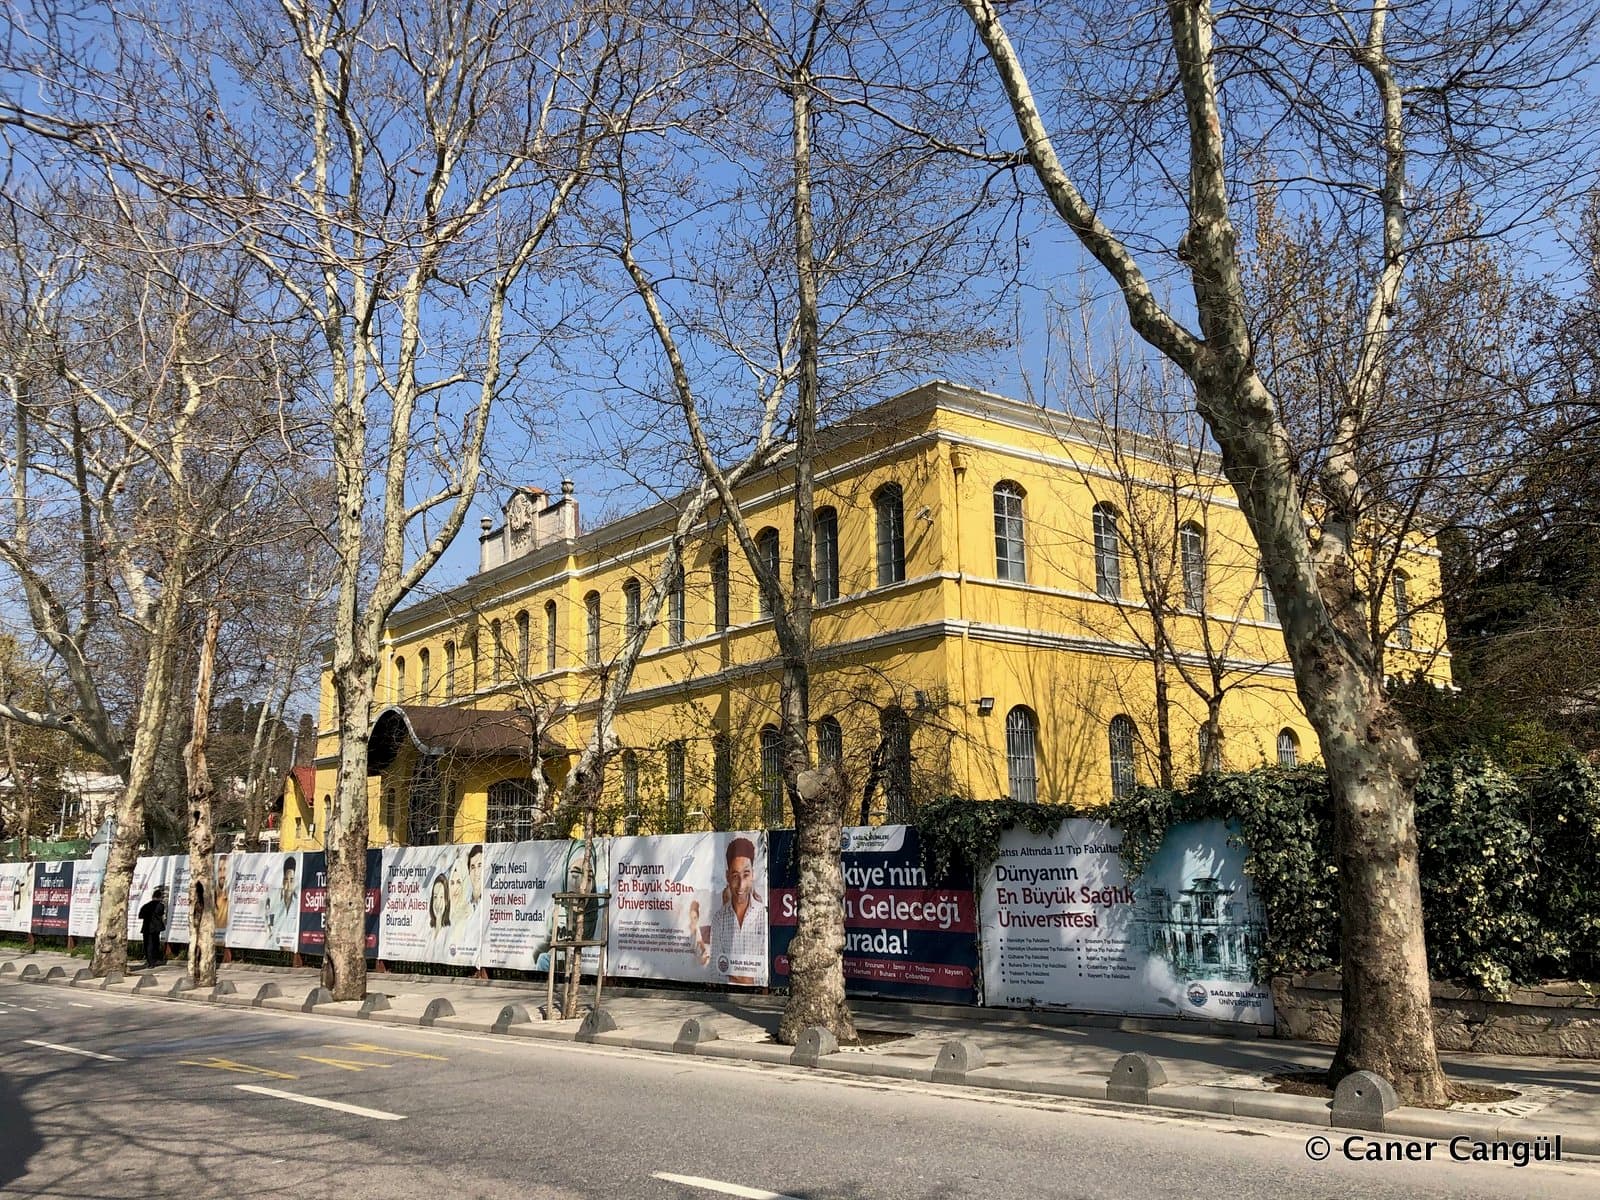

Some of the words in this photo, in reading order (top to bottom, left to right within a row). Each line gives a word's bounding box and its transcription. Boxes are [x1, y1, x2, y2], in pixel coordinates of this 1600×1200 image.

[1000, 848, 1019, 857] atısı
[1020, 846, 1052, 857] Altında
[1054, 846, 1065, 856] 11
[1066, 845, 1082, 857] Tıp
[1084, 843, 1121, 855] Fakülte
[388, 865, 427, 880] Türkiye'nin
[491, 863, 507, 874] Yeni
[508, 862, 527, 874] Nesil
[618, 862, 664, 878] Dünyanın
[995, 864, 1079, 885] Dünyanın
[490, 878, 546, 890] Laboratuvarlar
[841, 861, 928, 892] kiye'nin
[387, 881, 396, 893] En
[397, 881, 420, 896] Büyük
[617, 880, 630, 893] En
[632, 880, 662, 896] Büyük
[490, 894, 506, 905] Yeni
[507, 893, 526, 905] Nesil
[617, 894, 673, 911] Üniversitesi
[996, 888, 1018, 905] En
[1021, 887, 1077, 908] Büyük
[1080, 886, 1136, 908] Sağlık
[386, 898, 406, 913] Sağlık
[408, 898, 428, 911] Ailesi
[859, 895, 961, 929] Geleceği
[386, 914, 413, 927] Burada!
[490, 909, 513, 923] Eğitim
[515, 909, 546, 922] Burada!
[998, 907, 1099, 928] Üniversitesi
[844, 928, 909, 955] urada!
